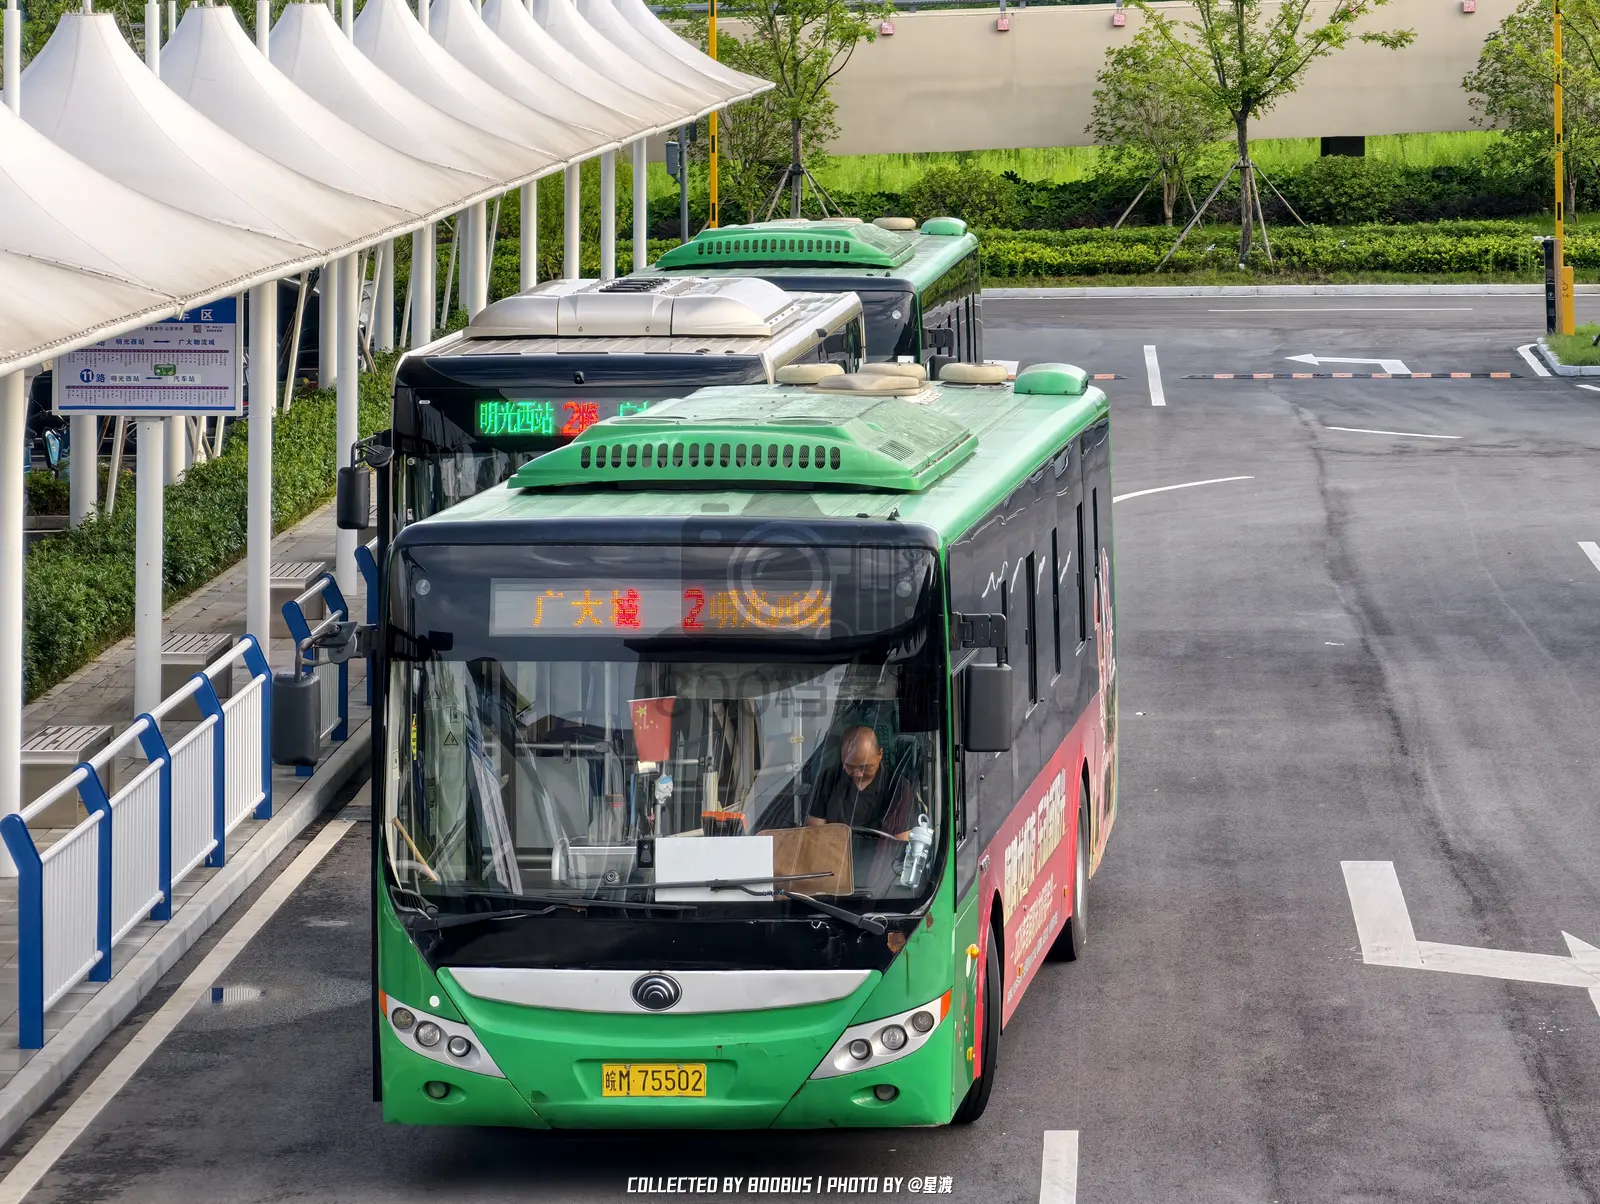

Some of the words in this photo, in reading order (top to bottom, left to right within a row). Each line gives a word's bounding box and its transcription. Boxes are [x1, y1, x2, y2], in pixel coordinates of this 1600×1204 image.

[178, 338, 216, 346] 广大物流城
[479, 401, 554, 434] 明光西站
